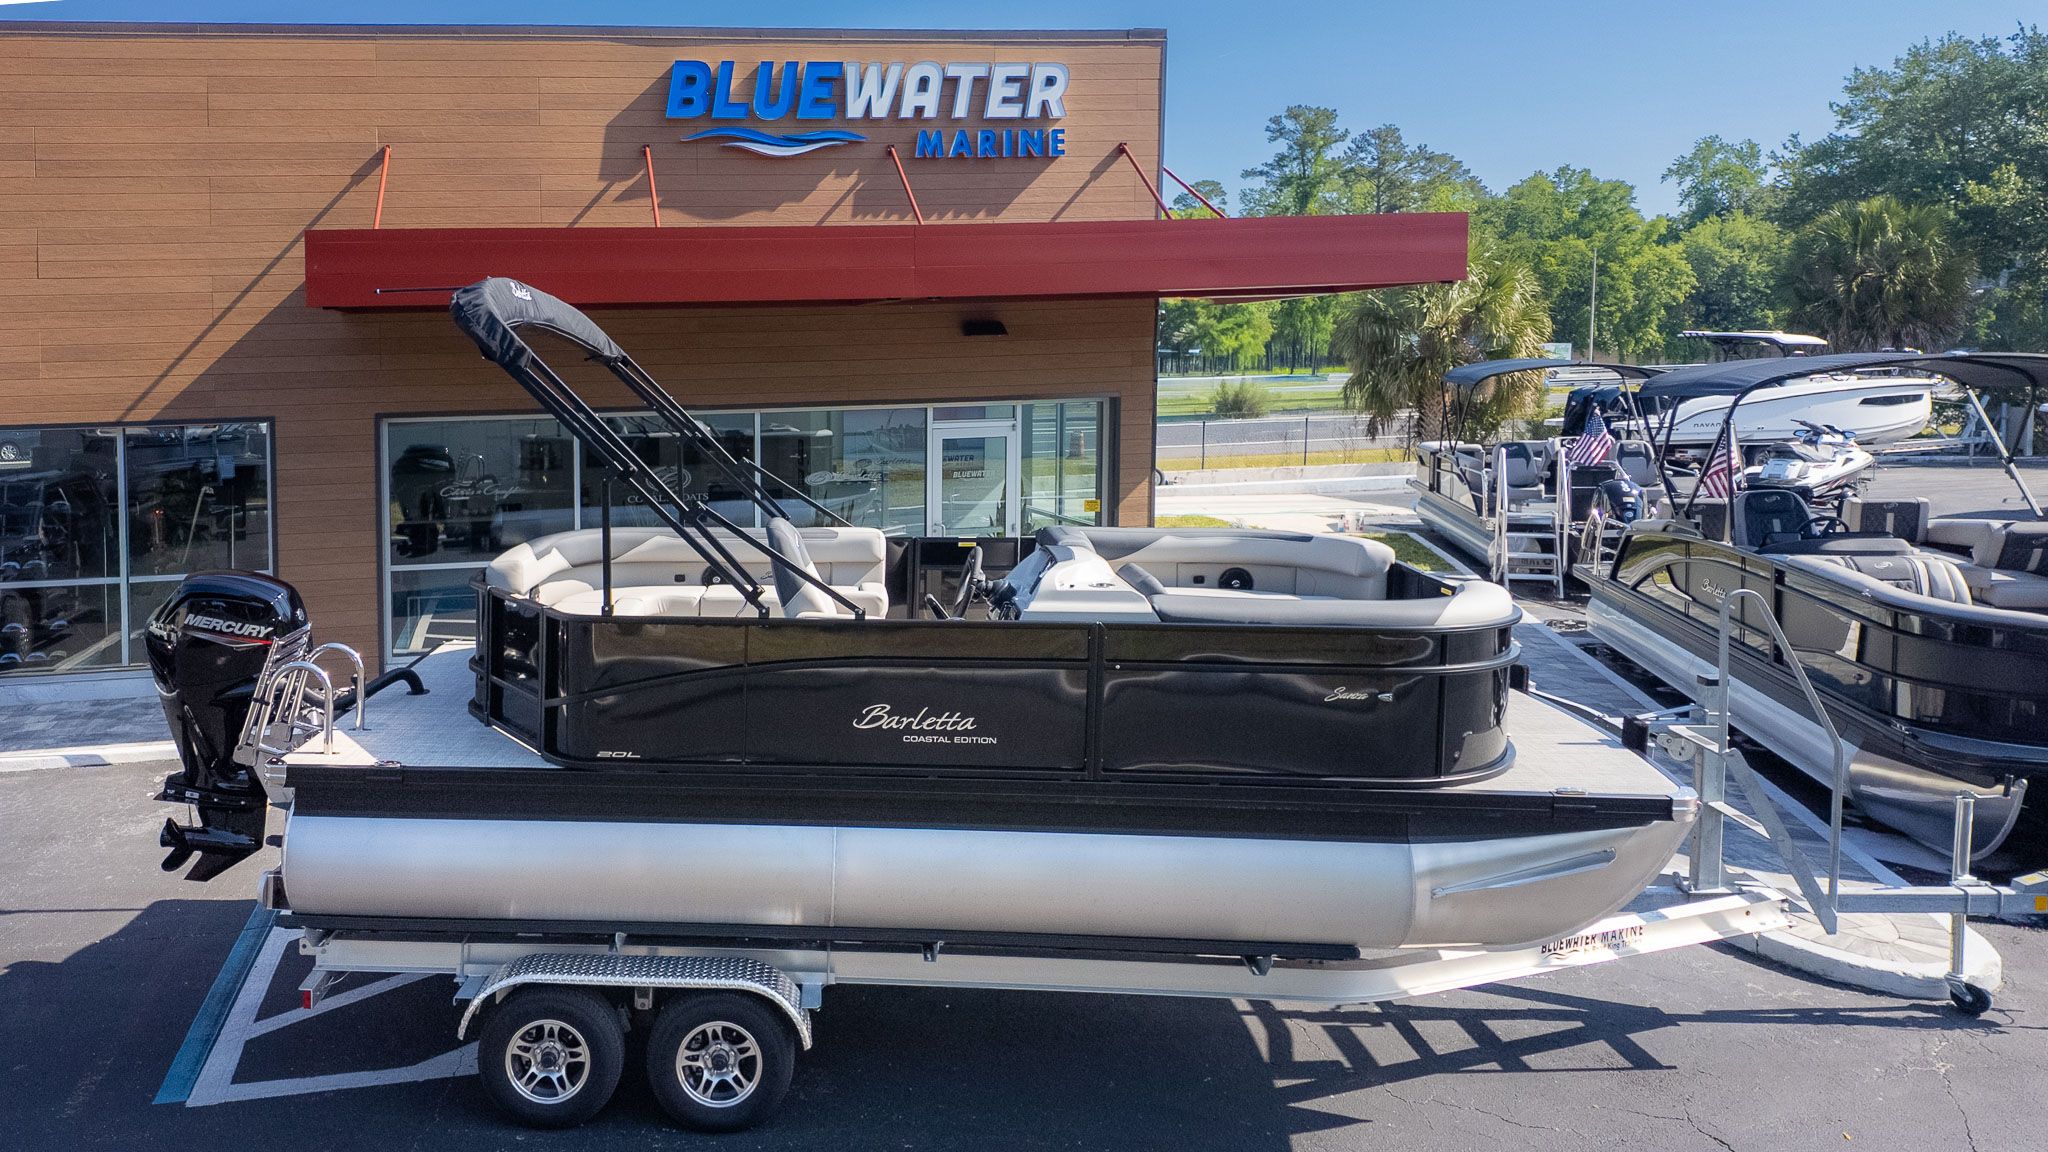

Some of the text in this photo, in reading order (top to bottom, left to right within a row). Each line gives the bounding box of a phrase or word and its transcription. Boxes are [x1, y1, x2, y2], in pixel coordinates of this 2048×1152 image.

[665, 60, 1070, 120] BLUEWATER
[915, 129, 1067, 158] MARINE
[184, 613, 274, 638] MERCURY
[852, 703, 977, 731] Barletta
[903, 735, 997, 745] COASTAL EDITION
[1541, 933, 1598, 954] BLUEWATER
[1601, 925, 1644, 943] MARINE
